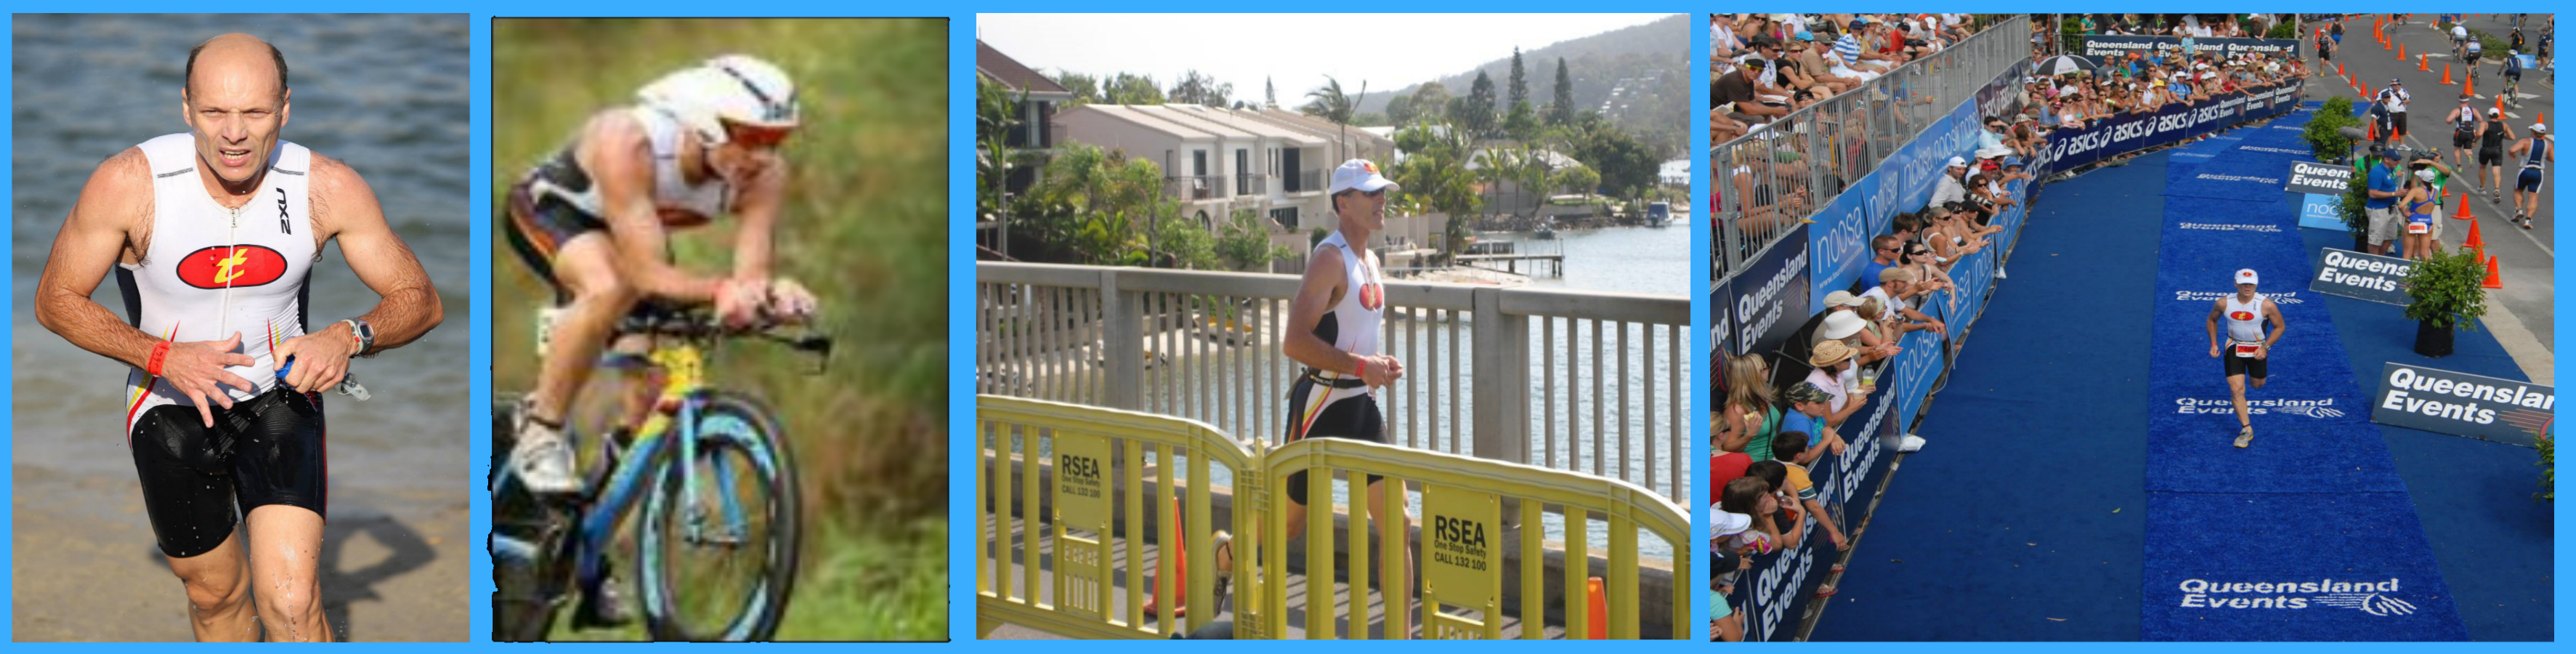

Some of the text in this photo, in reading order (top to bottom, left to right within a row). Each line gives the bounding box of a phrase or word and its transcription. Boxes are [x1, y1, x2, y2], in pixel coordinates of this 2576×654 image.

[2086, 40, 2153, 49] Queensland
[2158, 42, 2224, 51] Quesland
[2227, 43, 2294, 52] Quenslad
[2220, 95, 2246, 108] Queensland
[2246, 101, 2264, 110] Events
[2158, 113, 2187, 132] asics
[2198, 105, 2219, 124] asics
[2219, 108, 2235, 118] Events
[2113, 120, 2143, 142] asics
[2067, 131, 2099, 156] asics
[1903, 147, 1933, 192] noosa
[2291, 174, 2349, 190] Events
[276, 187, 292, 235] 2XU
[1817, 206, 1864, 274] noosa
[2324, 251, 2410, 277] Queens
[1738, 242, 1807, 324] Queensland
[2318, 267, 2397, 292] Events
[1742, 299, 1783, 355] Events
[2389, 368, 2554, 411] Queensla
[2176, 397, 2333, 406] Quensland
[2381, 389, 2496, 424] Events
[1840, 374, 1895, 473] Queensland
[1062, 454, 1100, 480] RSEA
[1843, 436, 1880, 504] Events
[1061, 475, 1101, 489] One Stop Safety
[1062, 484, 1076, 495] CALL
[1077, 486, 1088, 496] 132
[1435, 514, 1486, 549] RSEA
[1434, 539, 1486, 560] One Stop Safety
[1434, 552, 1487, 572] CALL 132 100
[1762, 546, 1812, 642] Events
[2179, 578, 2399, 594] Queensland
[2180, 594, 2308, 609] Events
